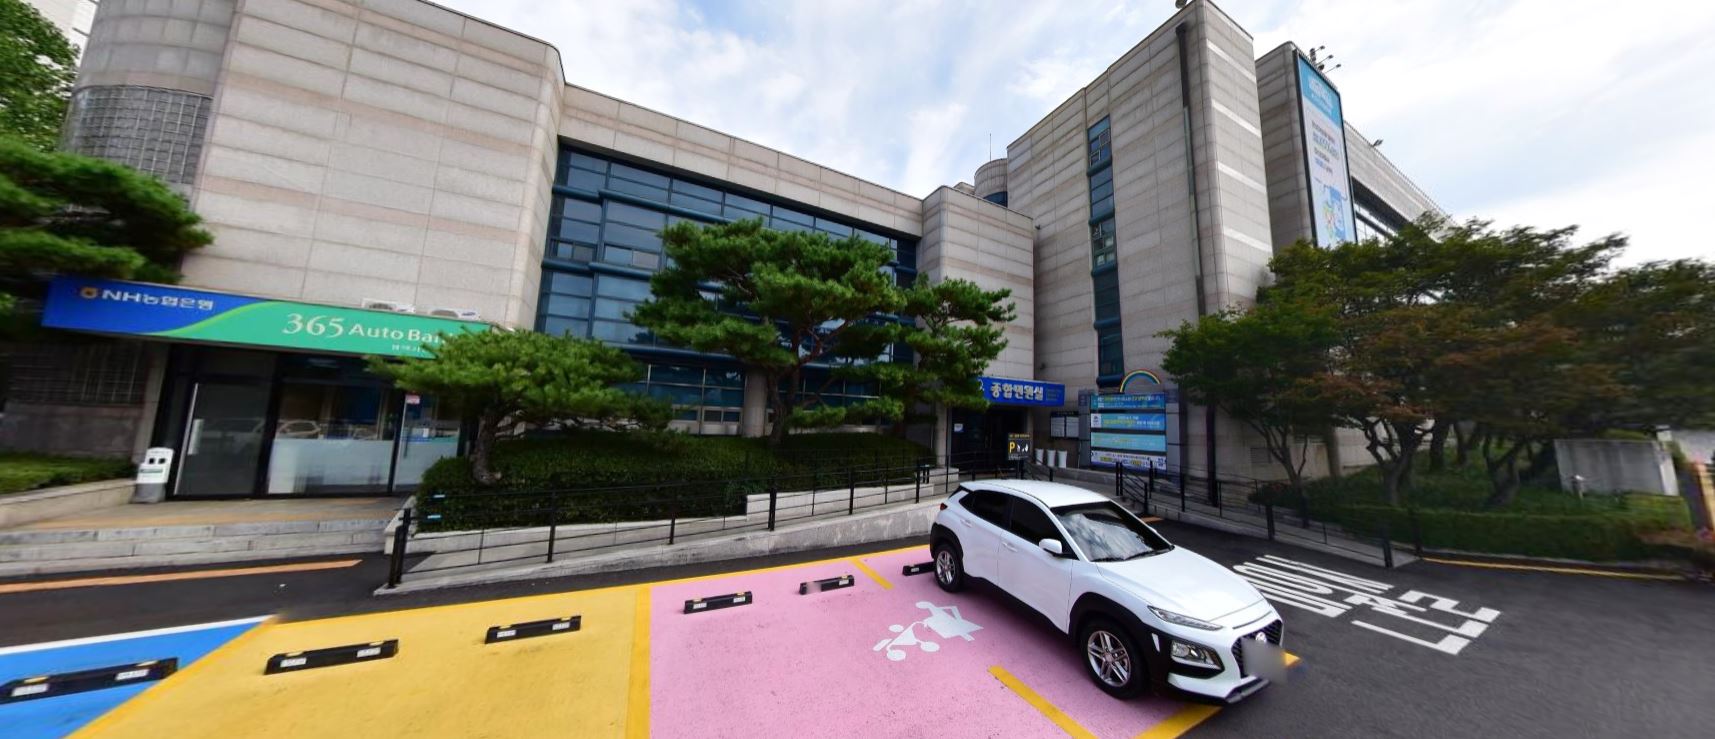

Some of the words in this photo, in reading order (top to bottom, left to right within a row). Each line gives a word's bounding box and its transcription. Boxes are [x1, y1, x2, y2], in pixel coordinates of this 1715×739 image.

[102, 289, 214, 311] NH농협은행
[282, 312, 345, 338] 365
[348, 323, 404, 341] Auto
[407, 328, 458, 345] Ban
[990, 381, 1044, 401] 종합민원실
[1009, 441, 1016, 454] P
